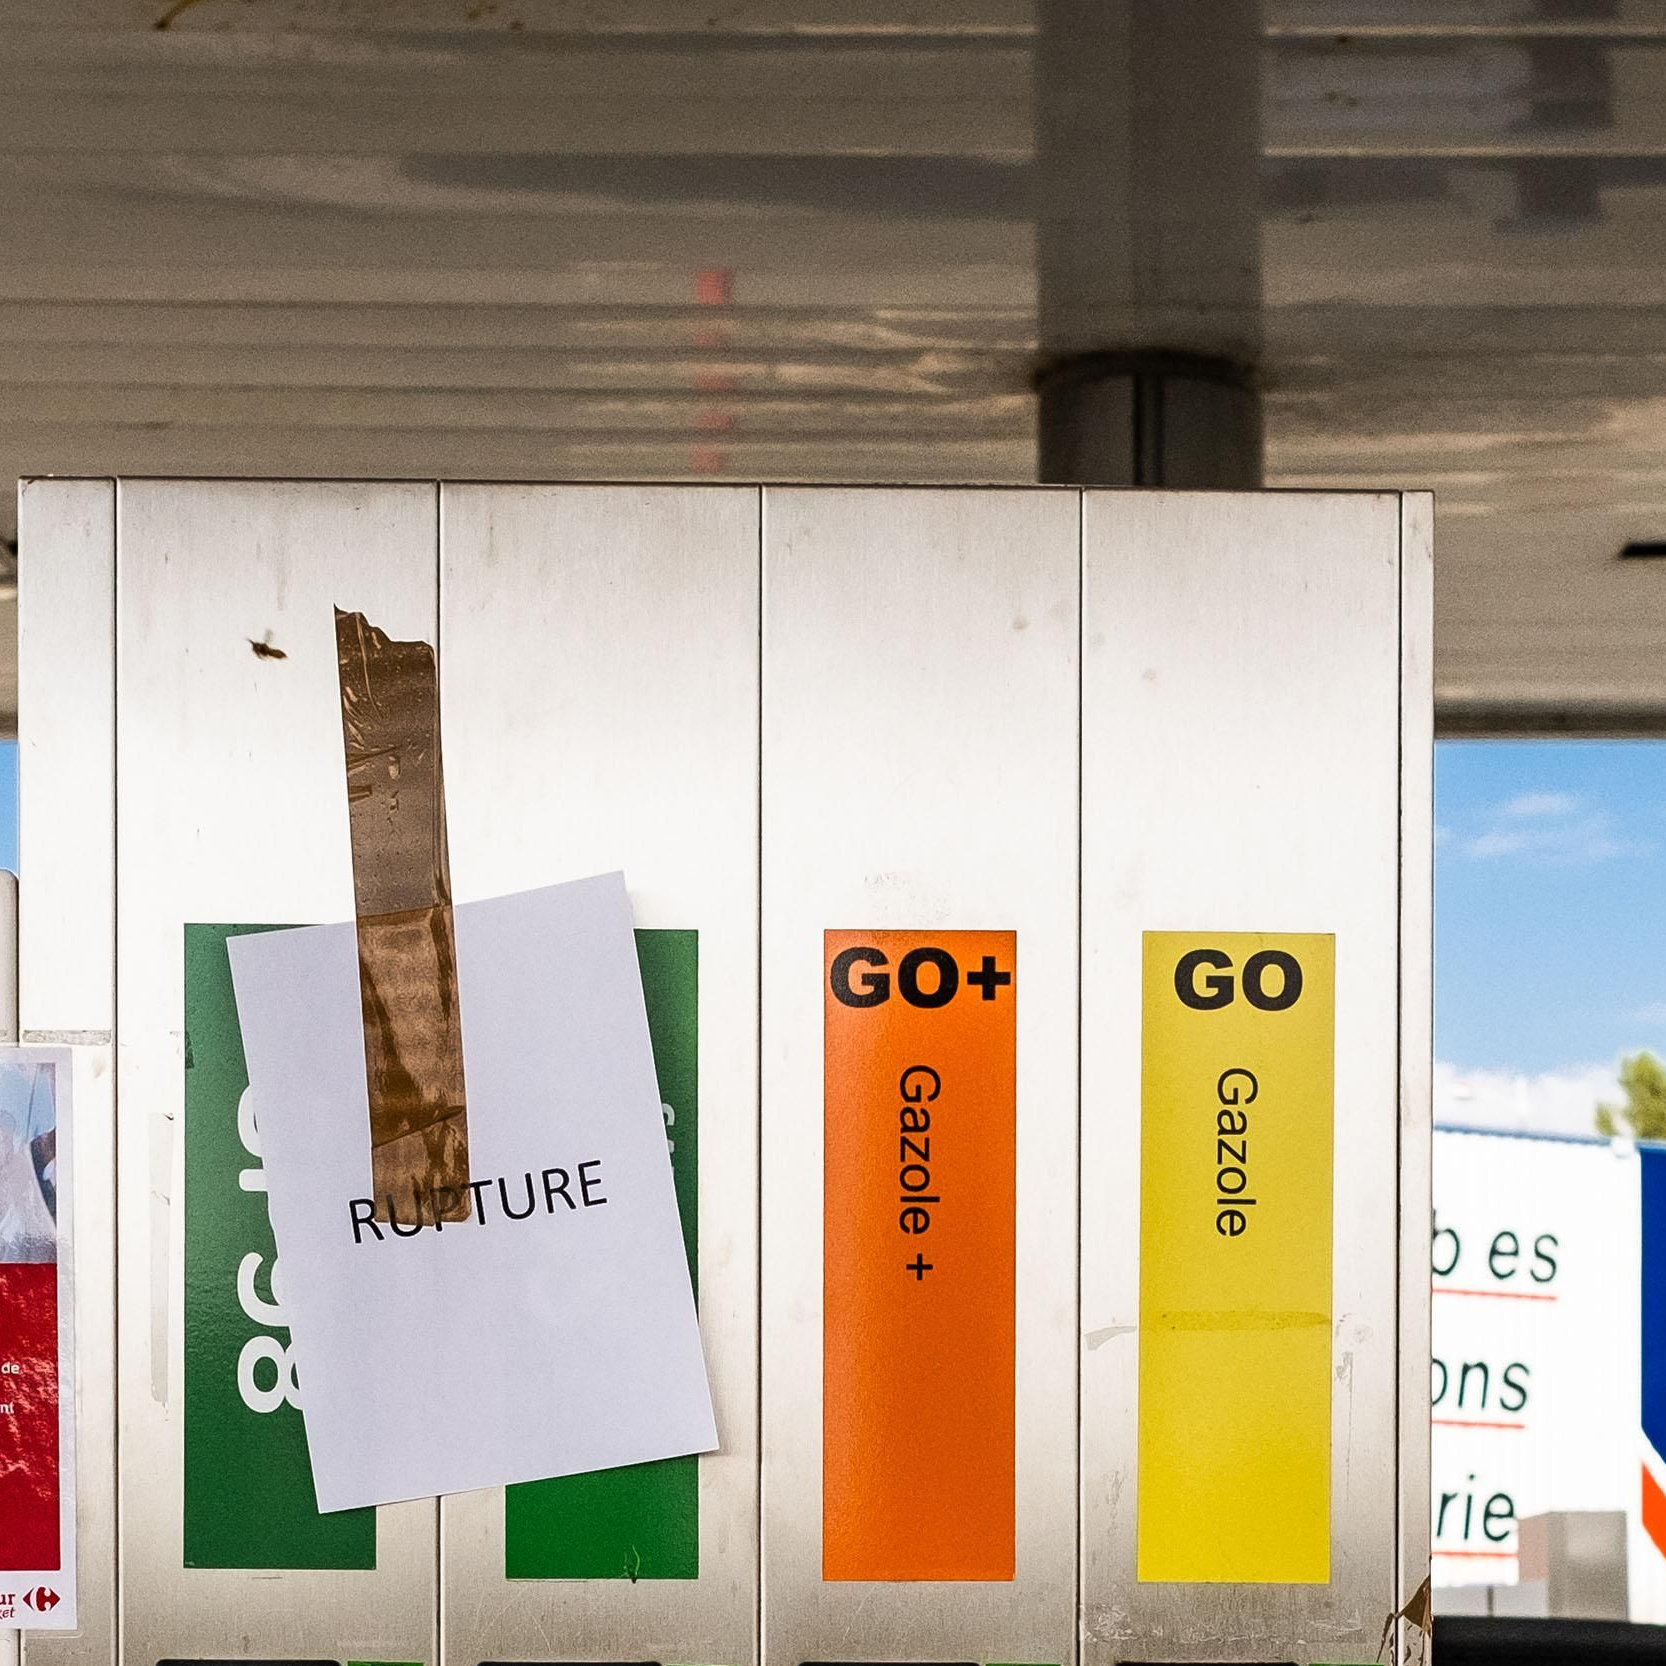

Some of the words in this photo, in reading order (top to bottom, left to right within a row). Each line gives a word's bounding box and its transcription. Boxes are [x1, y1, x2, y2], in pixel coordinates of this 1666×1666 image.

[830, 947, 1012, 1010] GO+
[1174, 949, 1304, 1012] GO
[899, 1064, 942, 1235] Gazole
[1216, 1067, 1259, 1237] Gazole
[349, 1159, 608, 1244] RUPTURE
[906, 1254, 933, 1282] +
[1, 1361, 20, 1375] de
